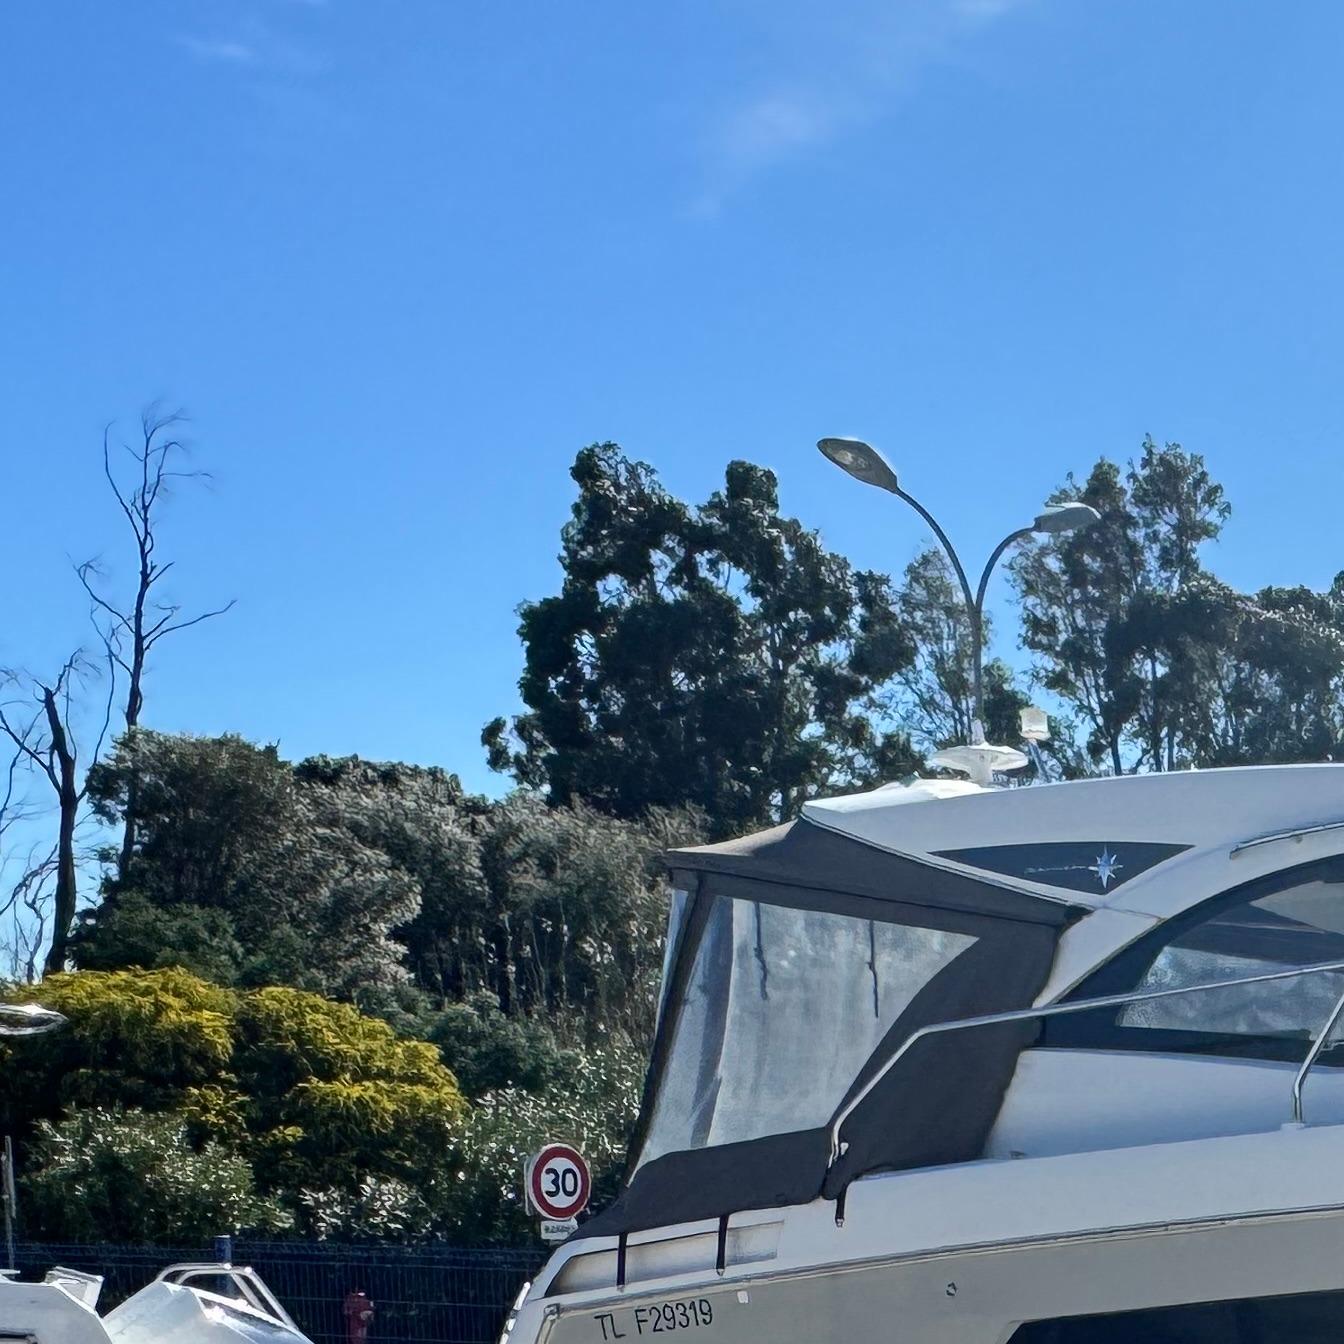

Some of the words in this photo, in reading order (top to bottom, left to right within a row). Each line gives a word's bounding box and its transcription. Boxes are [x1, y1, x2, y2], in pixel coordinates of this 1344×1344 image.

[544, 1168, 578, 1197] 30
[594, 1314, 626, 1340] TL
[635, 1299, 713, 1335] F29319
